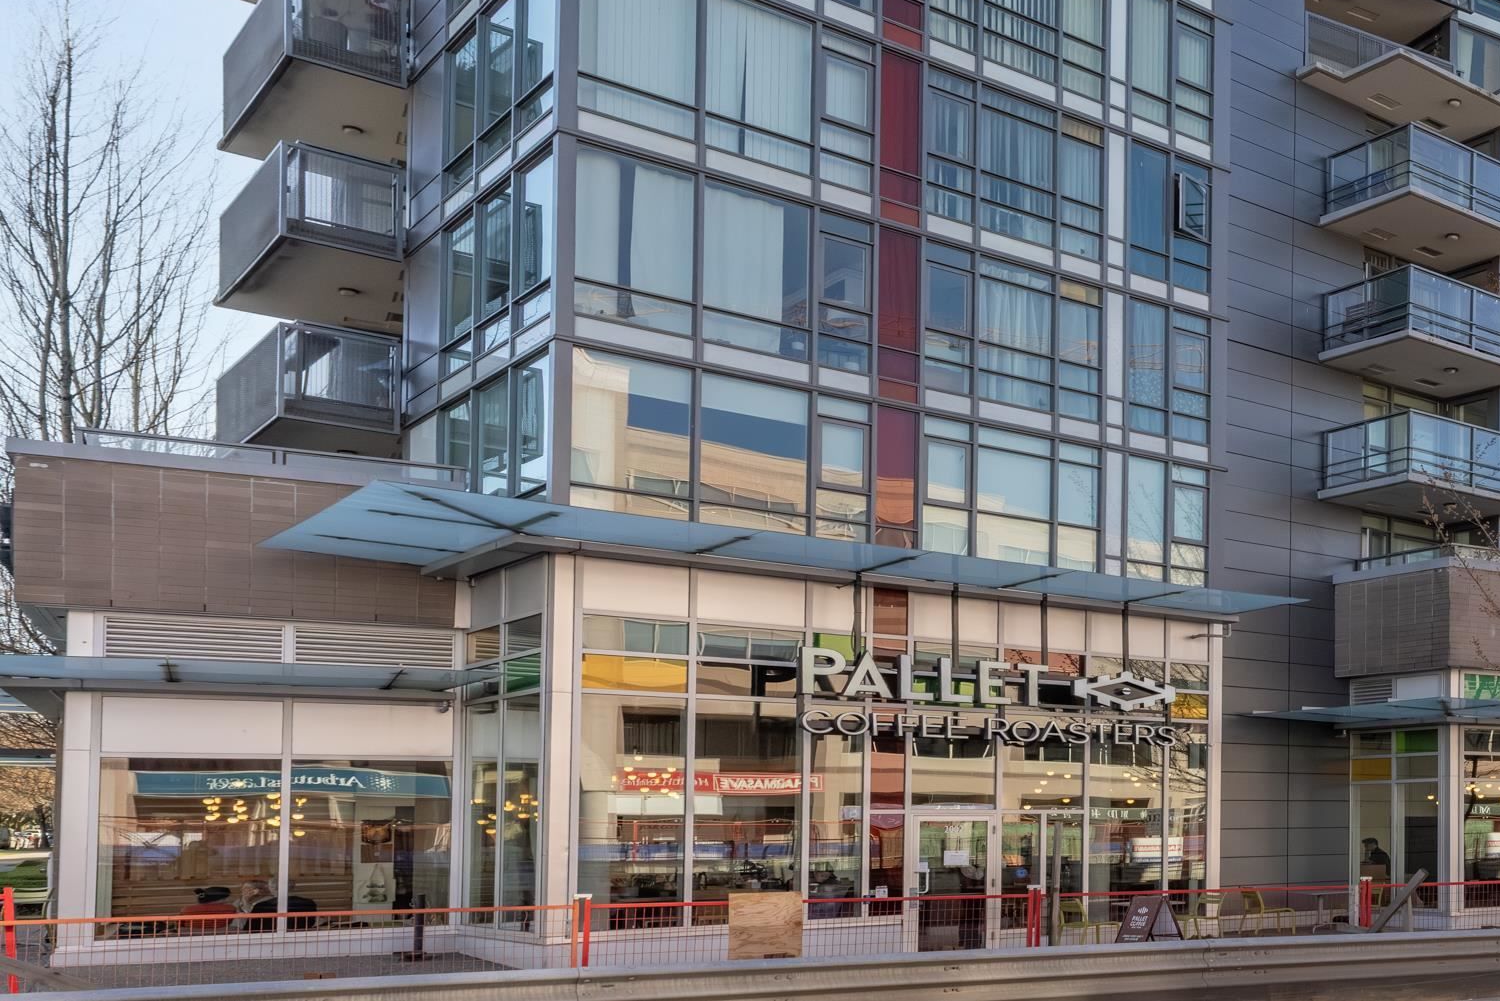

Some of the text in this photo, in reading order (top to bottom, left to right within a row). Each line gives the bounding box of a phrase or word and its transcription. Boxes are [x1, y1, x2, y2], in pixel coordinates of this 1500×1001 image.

[801, 646, 1048, 706] PALLET
[801, 709, 1177, 746] COFFEE ROASTERS
